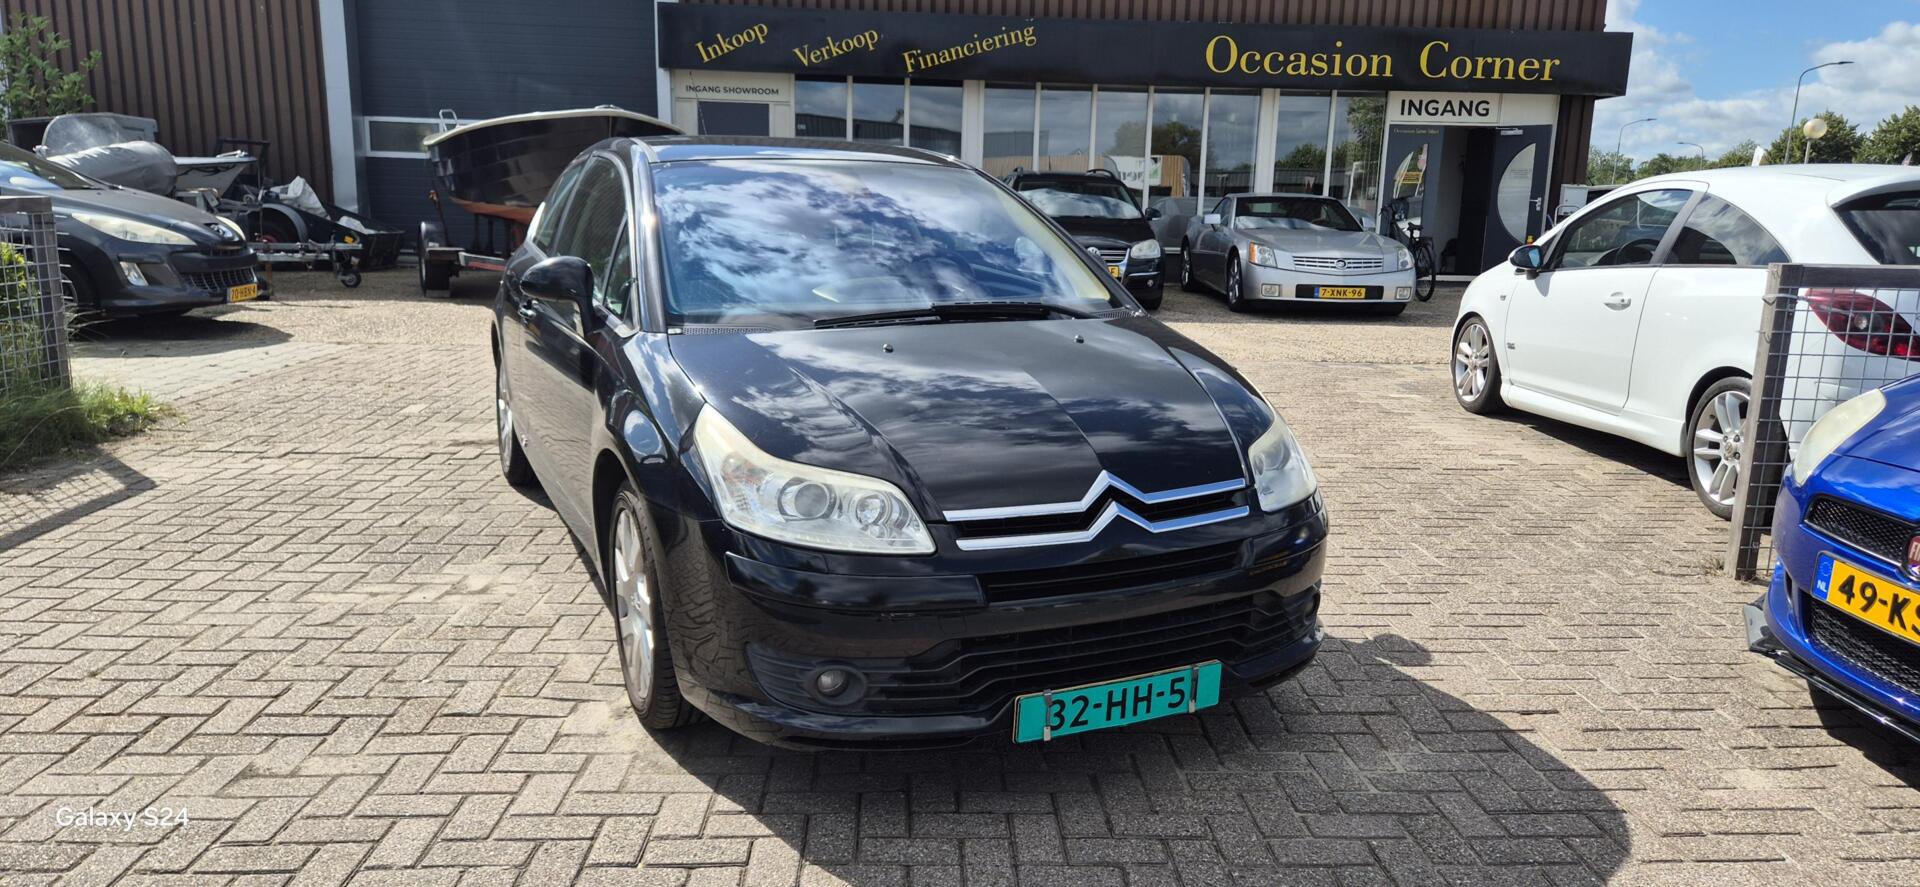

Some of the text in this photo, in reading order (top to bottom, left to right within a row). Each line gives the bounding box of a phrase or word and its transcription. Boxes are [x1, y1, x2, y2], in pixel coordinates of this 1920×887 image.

[696, 19, 769, 63] Inkoop
[793, 26, 879, 68] Verkoop
[902, 25, 1037, 73] Financiering
[1205, 35, 1561, 81] Occasion Corner
[686, 84, 779, 95] INGANG SHOWROOM
[1400, 98, 1491, 118] INGANG
[1321, 288, 1363, 297] 7-XNK-96
